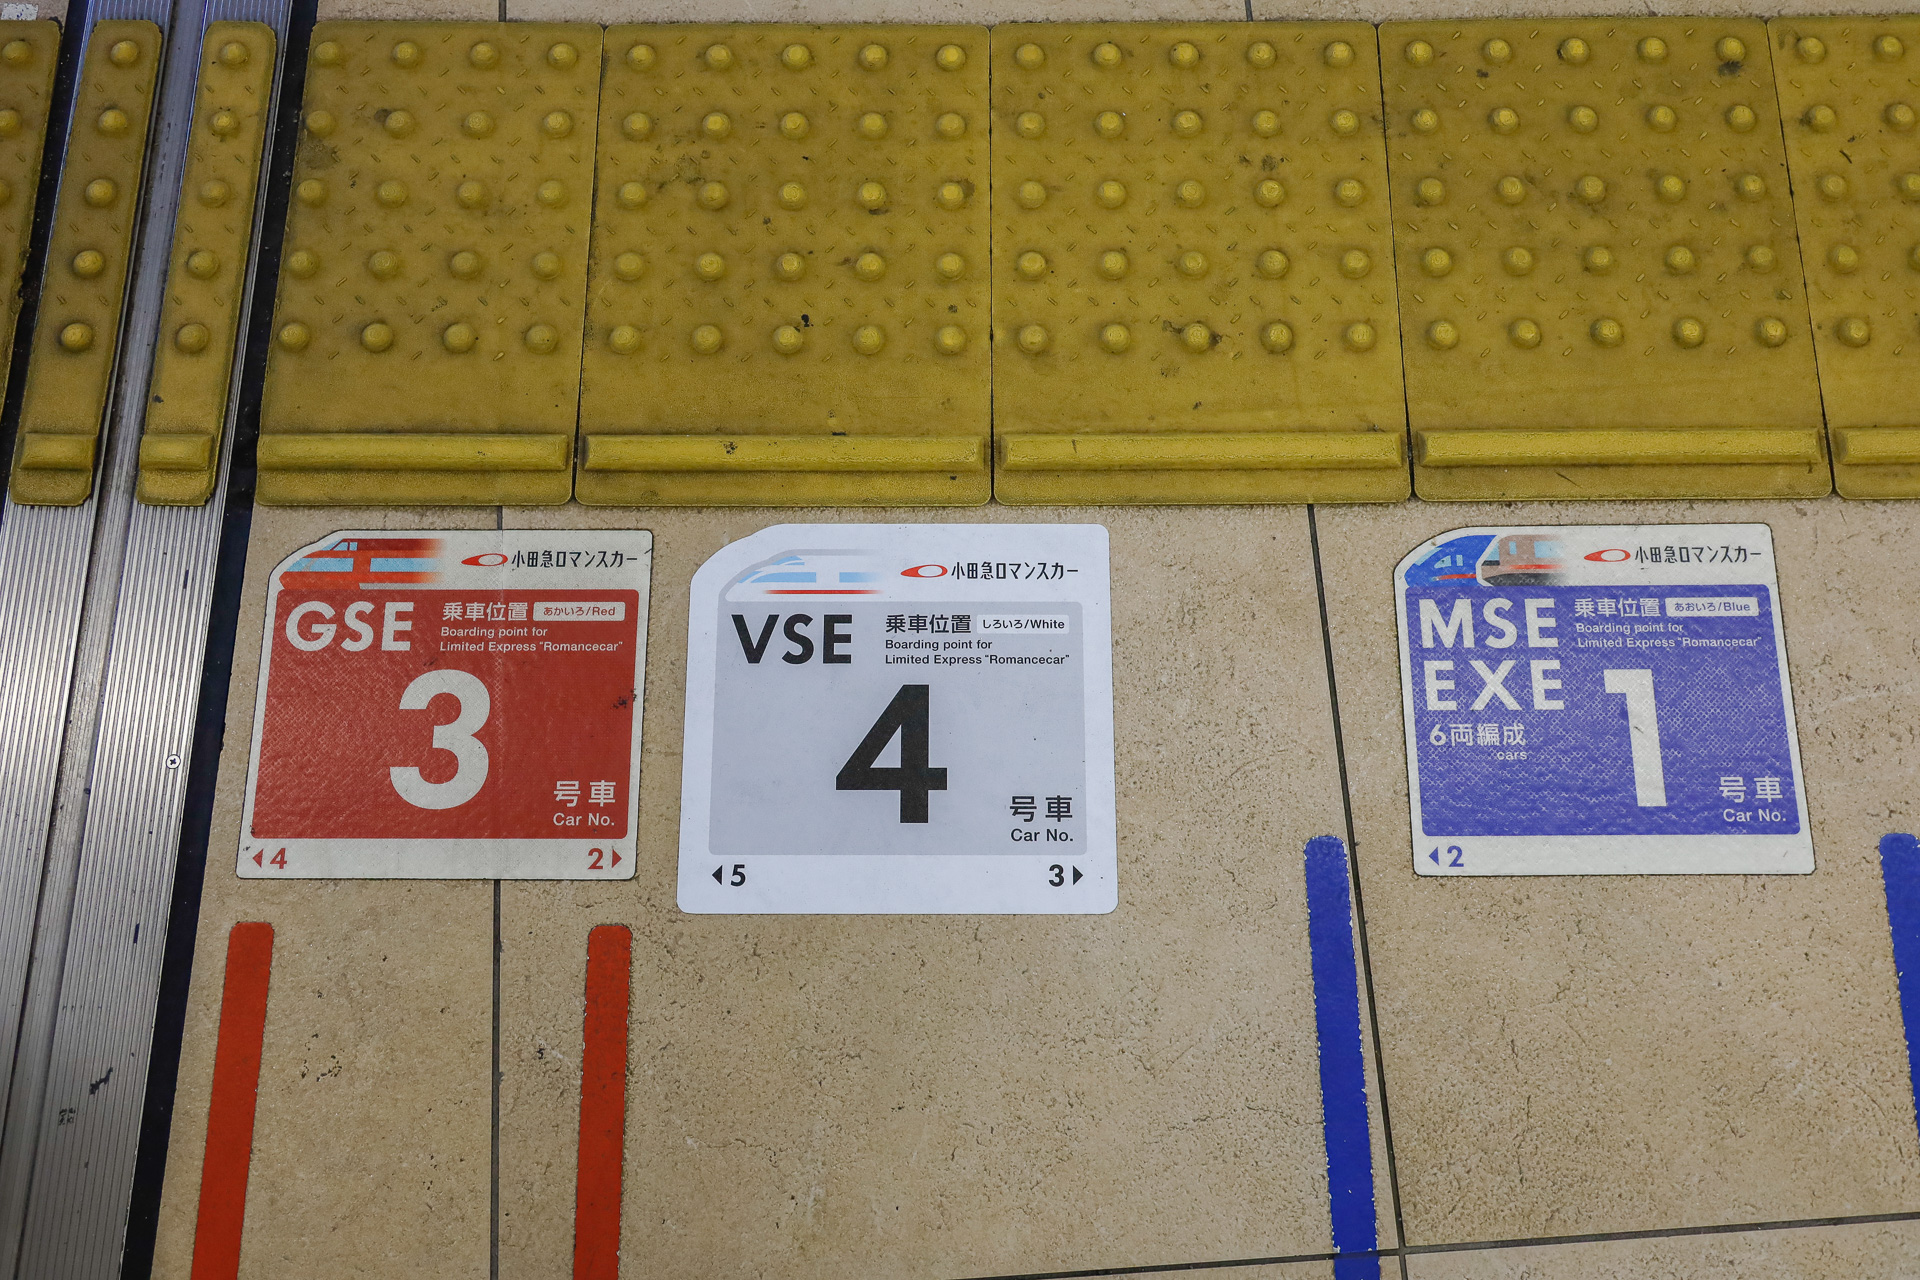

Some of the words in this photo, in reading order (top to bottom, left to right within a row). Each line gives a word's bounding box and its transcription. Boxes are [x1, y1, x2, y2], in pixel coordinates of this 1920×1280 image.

[511, 550, 638, 567] 小田急ロマンスカー
[1635, 546, 1762, 564] 小田急ロマンスカー
[951, 562, 1079, 580] 小田急ロマンスカー
[442, 602, 528, 621] 乗車位置
[543, 605, 616, 617] あかいろ/Red
[1574, 598, 1661, 618] 乗車位置
[1674, 601, 1751, 612] あおいろ/Blue
[285, 601, 415, 652] GSE
[885, 614, 971, 634] 乗車位置
[982, 618, 1065, 630] しろいろ/White
[1419, 598, 1559, 649] MSE
[1576, 622, 1631, 635] Boarding
[1635, 623, 1664, 635] point
[1668, 622, 1683, 632] for
[441, 627, 494, 639] Boarding
[498, 627, 528, 639] point
[531, 627, 548, 637] for
[731, 614, 853, 664] VSE
[440, 641, 484, 652] Limited
[489, 642, 536, 653] Express
[885, 639, 939, 652] Boarding
[943, 640, 973, 652] point
[977, 639, 992, 650] for
[1578, 637, 1623, 648] Limited
[1626, 638, 1675, 649] Express
[885, 654, 929, 665] Limited
[934, 655, 982, 666] Express
[1424, 660, 1565, 710] EXE
[390, 669, 491, 809] 3
[1429, 723, 1526, 746] 6両編成
[1604, 669, 1667, 807] 1
[835, 684, 947, 823] 4
[1497, 750, 1527, 760] cars
[553, 813, 580, 826] Car
[588, 813, 615, 826] No.
[1723, 809, 1752, 822] Car
[1759, 809, 1786, 822] No.
[1010, 829, 1039, 842] Car
[1047, 829, 1074, 842] No.
[270, 848, 287, 869] 4
[588, 848, 604, 869] 2
[1447, 846, 1464, 867] 2
[730, 865, 746, 887] 5
[1049, 865, 1065, 887] 3
